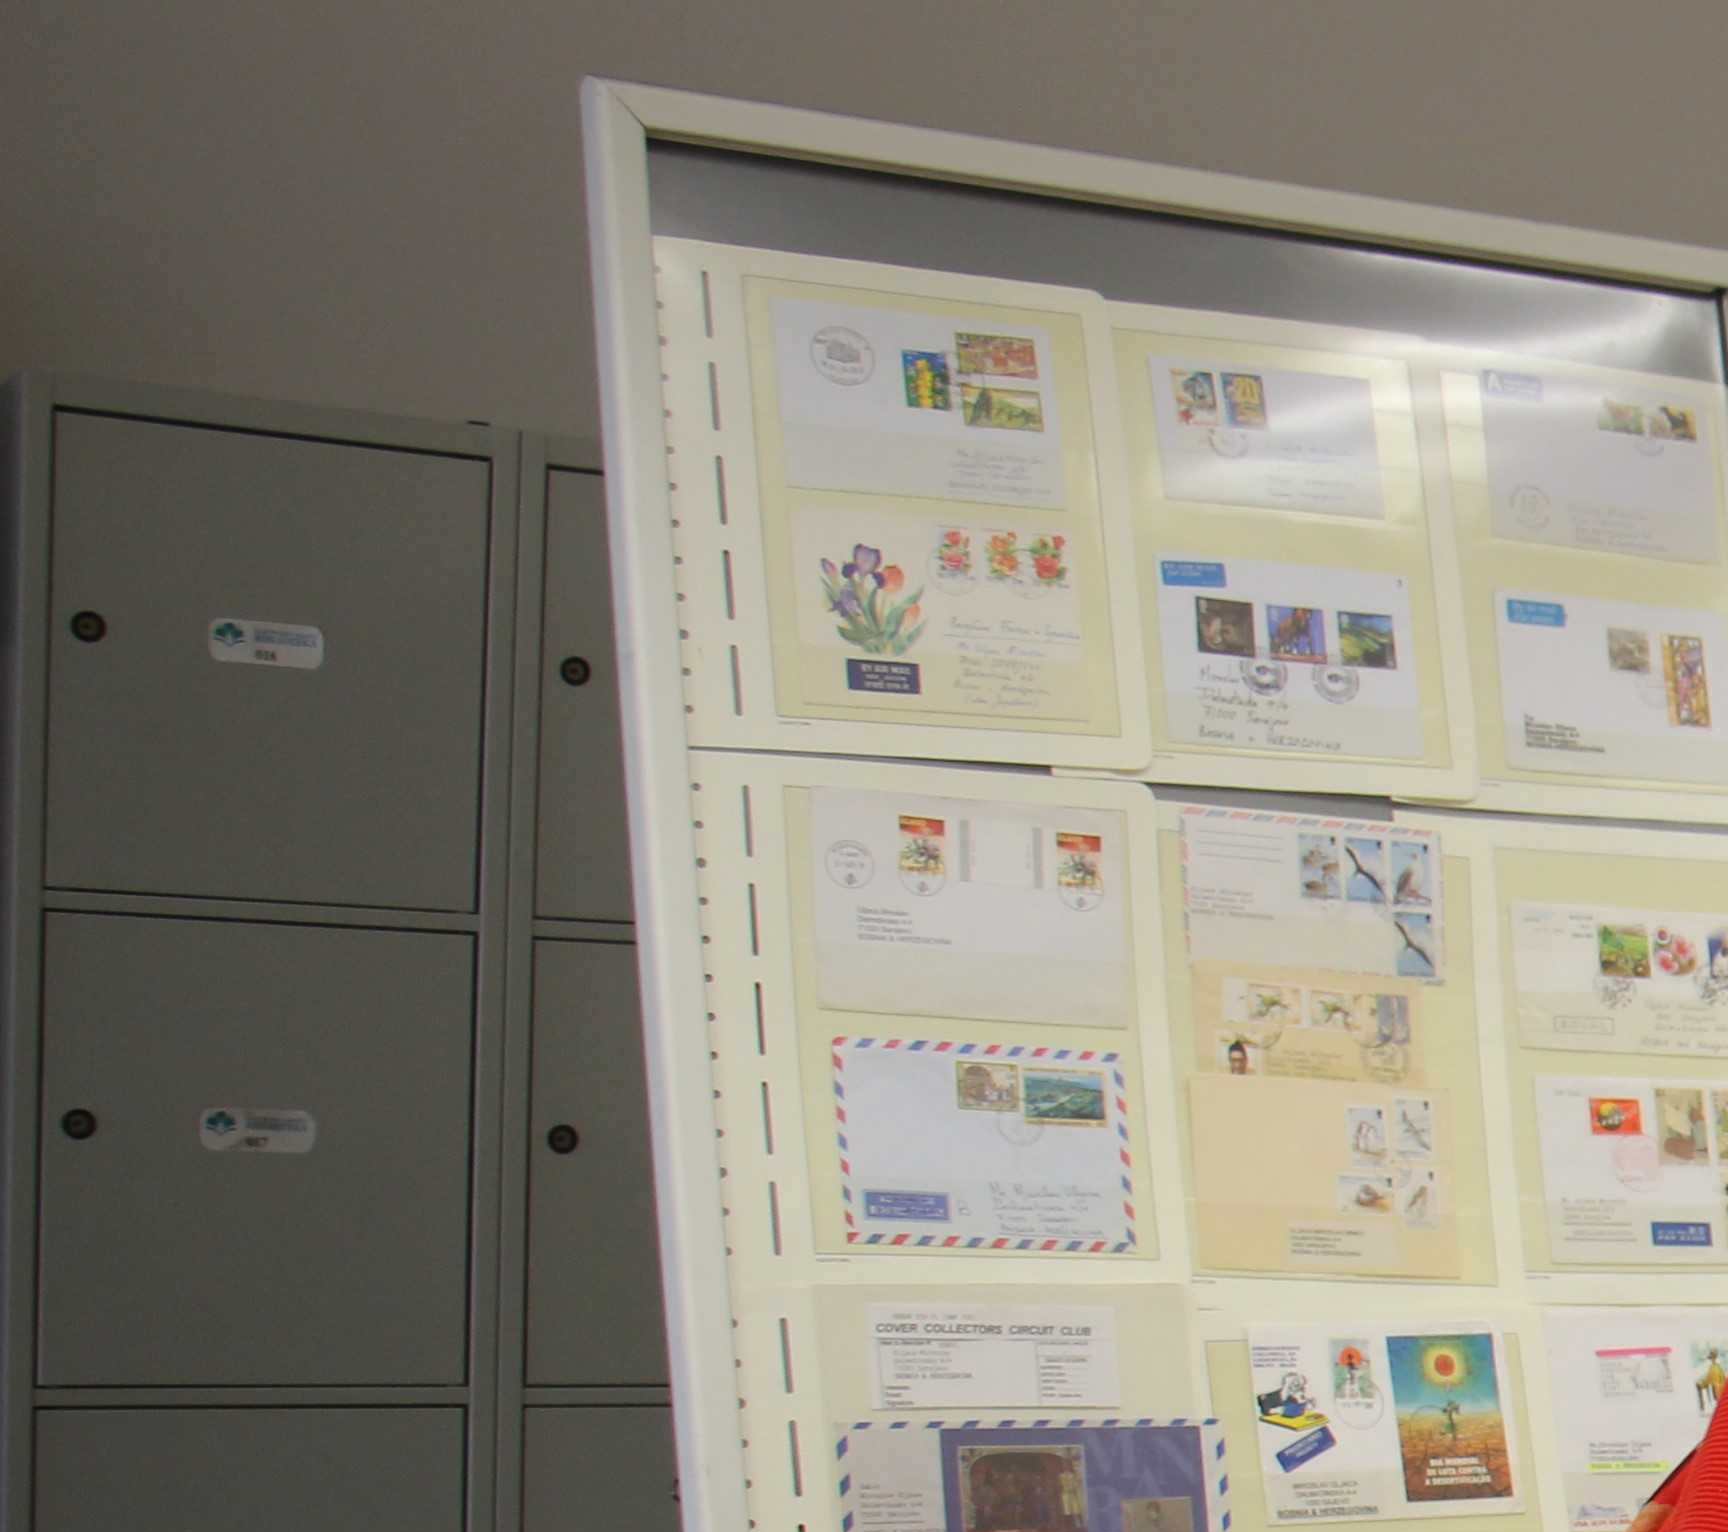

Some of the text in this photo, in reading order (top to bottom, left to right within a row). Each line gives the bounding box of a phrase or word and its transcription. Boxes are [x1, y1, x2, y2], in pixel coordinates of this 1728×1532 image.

[875, 1323, 1092, 1336] COVER COLLECTORS CIRCUIT CLUB
